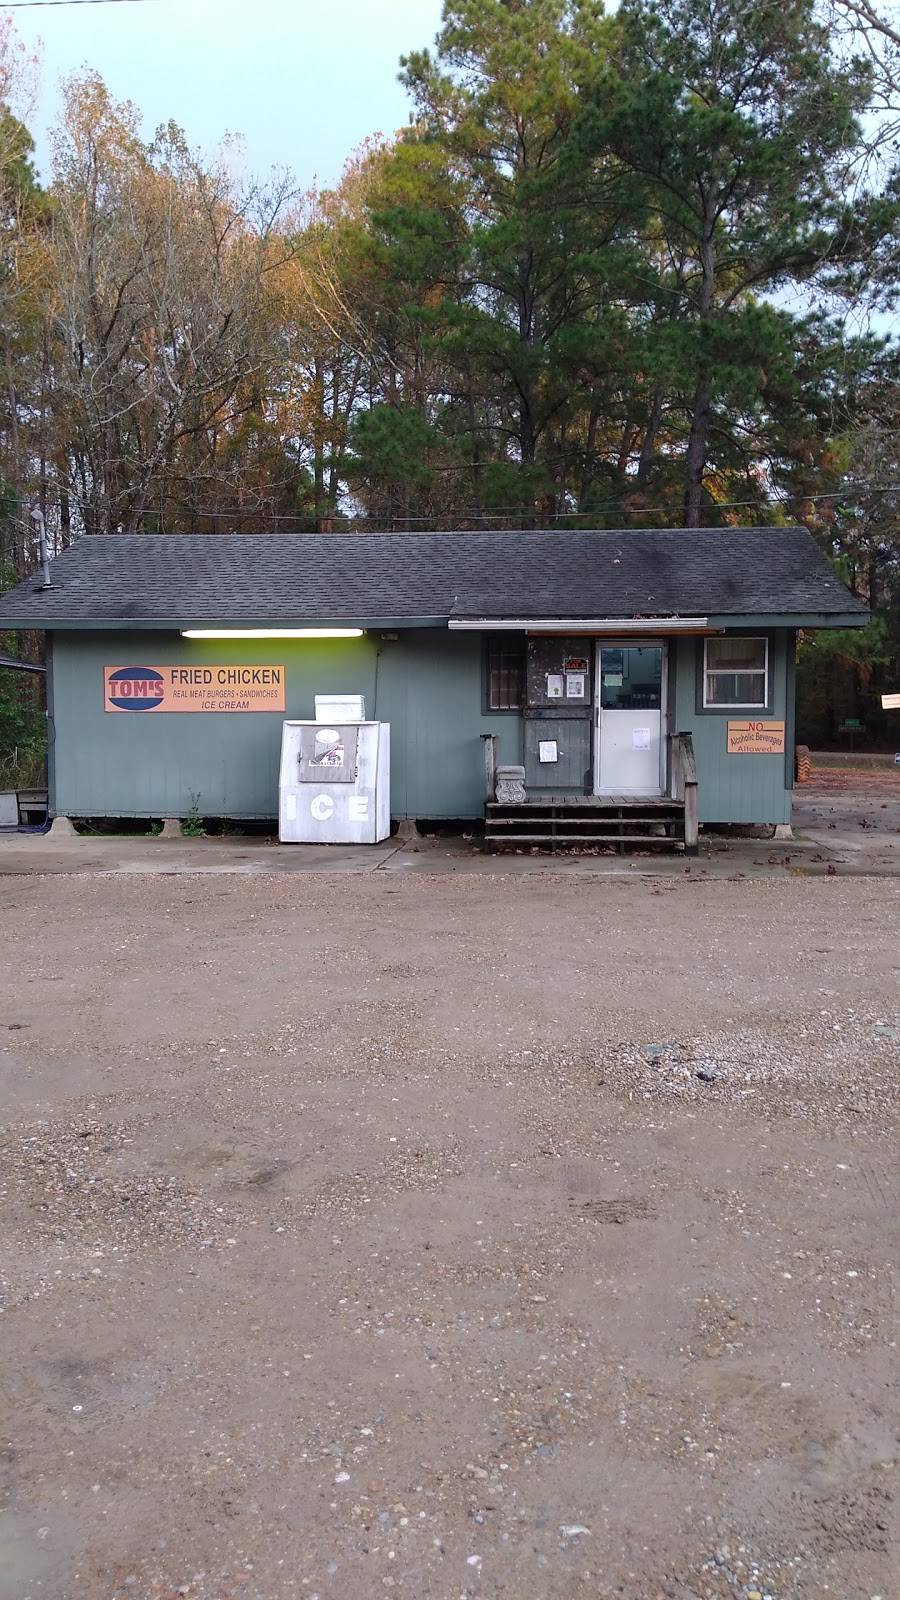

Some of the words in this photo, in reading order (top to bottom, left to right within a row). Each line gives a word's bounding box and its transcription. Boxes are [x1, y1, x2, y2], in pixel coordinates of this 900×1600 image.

[171, 669, 212, 684] FRIED
[217, 669, 280, 684] CHICKEN
[108, 681, 165, 697] TOM'S
[173, 689, 188, 698] REAL
[190, 689, 206, 698] MEAT
[207, 689, 235, 698] BURGERS
[240, 689, 279, 698] SANDWICHES
[201, 700, 216, 709] ICE
[218, 700, 250, 709] CREAM
[748, 722, 764, 731] NO
[731, 732, 754, 746] Alcoholic
[755, 732, 783, 746] Beverages
[286, 794, 368, 821] ICE
